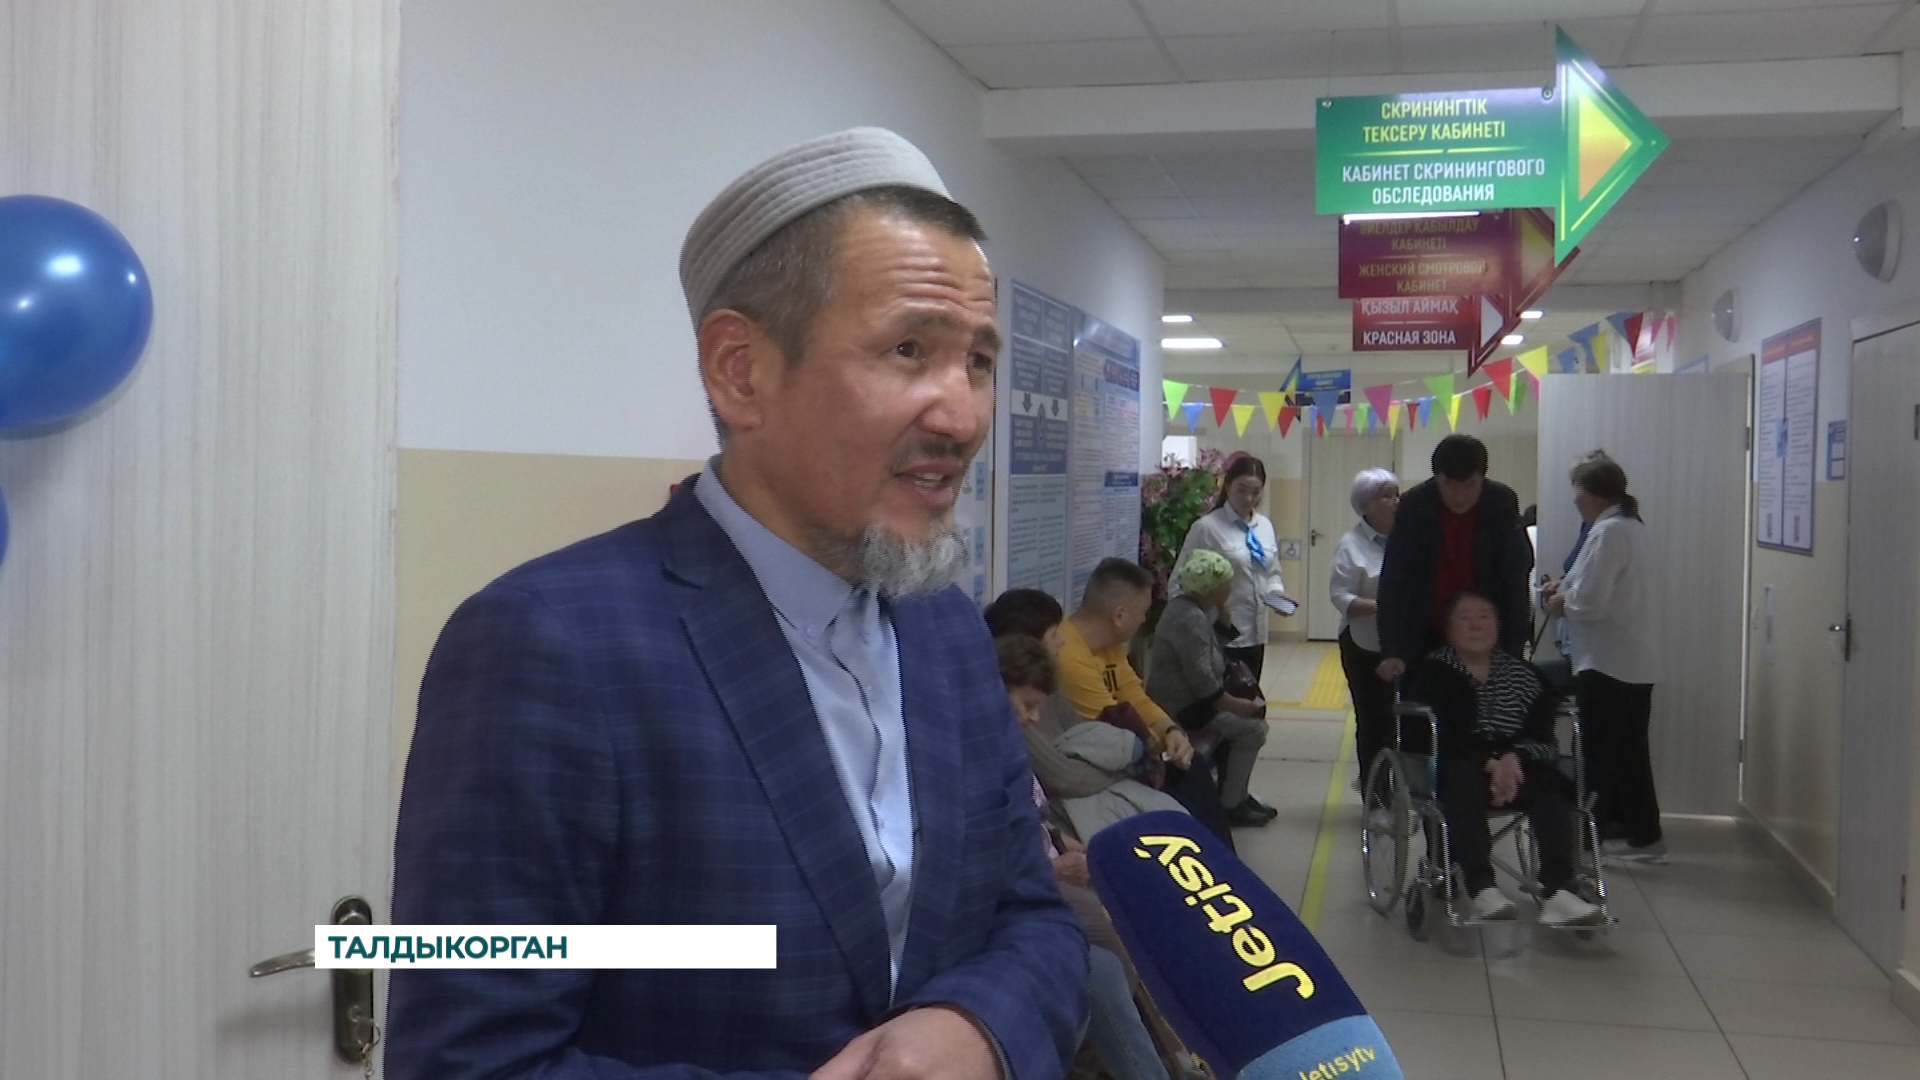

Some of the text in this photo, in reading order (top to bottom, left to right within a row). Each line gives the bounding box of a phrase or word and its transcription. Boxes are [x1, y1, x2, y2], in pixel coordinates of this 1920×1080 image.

[1381, 98, 1488, 119] СКРИНИНГТІК
[1363, 121, 1506, 143] ТЕКСЕРУ КАБИНЕТІ
[1342, 158, 1546, 182] КАБИНЕТ СКРИНИНГОВОГО
[1372, 184, 1495, 206] ОБСЛЕДОВАНИЯ
[1391, 237, 1447, 250] КАБИНЕТІ
[1359, 259, 1486, 277] ЖЕНСКИЙ СМОТРОВОЙ
[1396, 279, 1448, 292] КАБИНЕТ
[1362, 299, 1410, 316] ҚЫЗЫЛ
[1363, 330, 1457, 344] КРАСНАЯ ЗОНА
